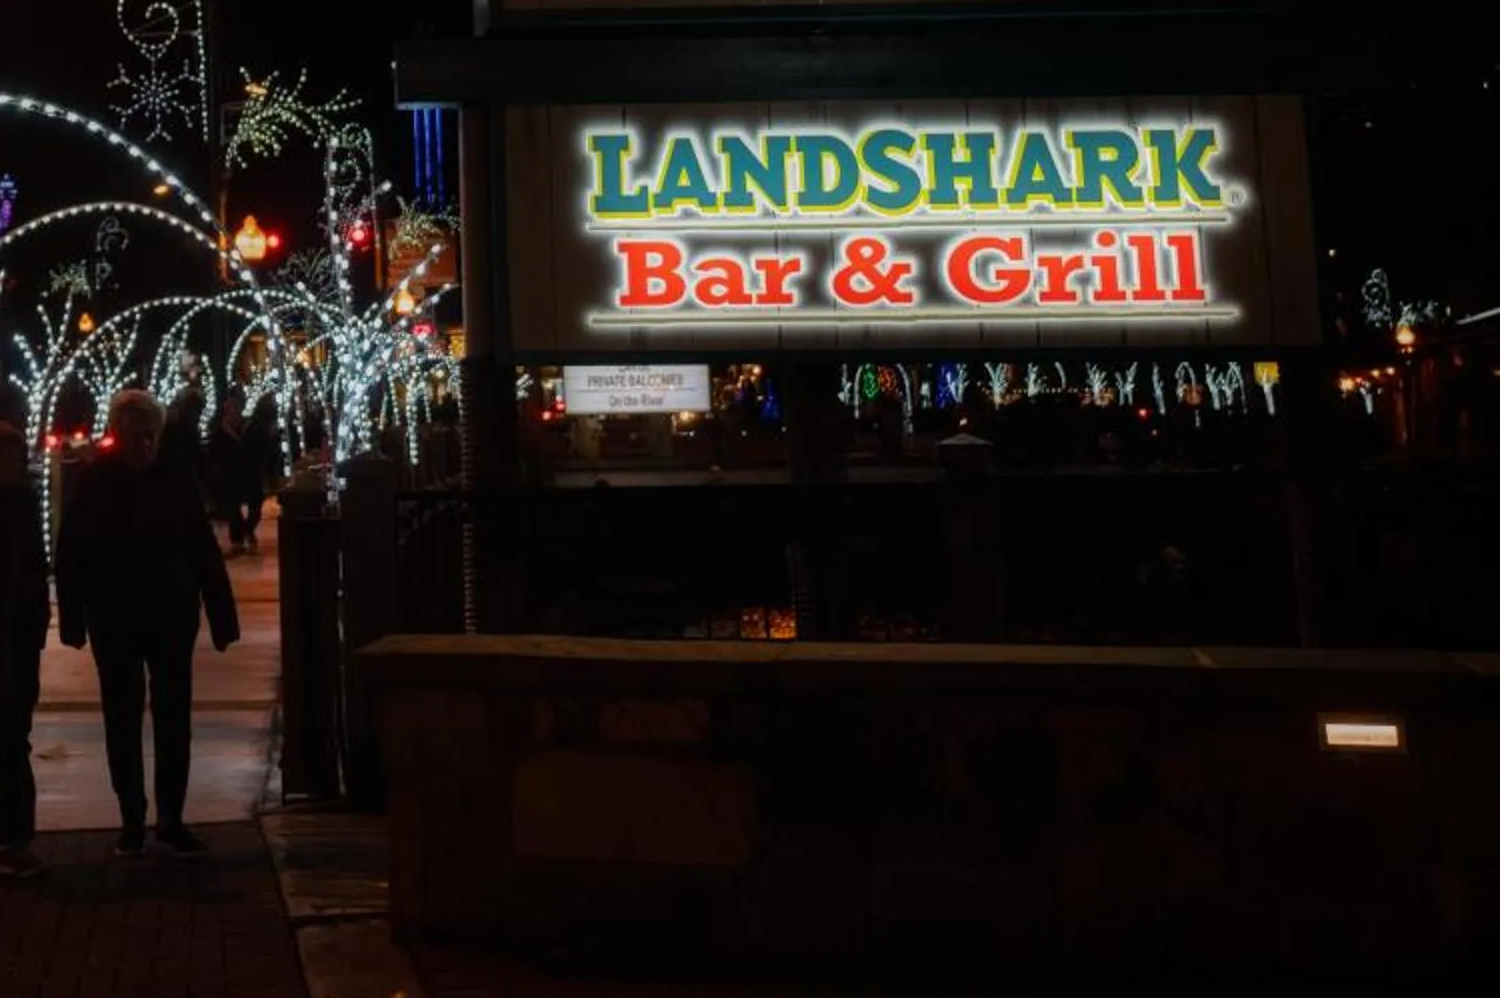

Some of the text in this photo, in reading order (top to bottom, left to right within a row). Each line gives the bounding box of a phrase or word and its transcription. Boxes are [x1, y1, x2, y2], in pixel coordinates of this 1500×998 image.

[617, 230, 1208, 307] Bar & Grill
